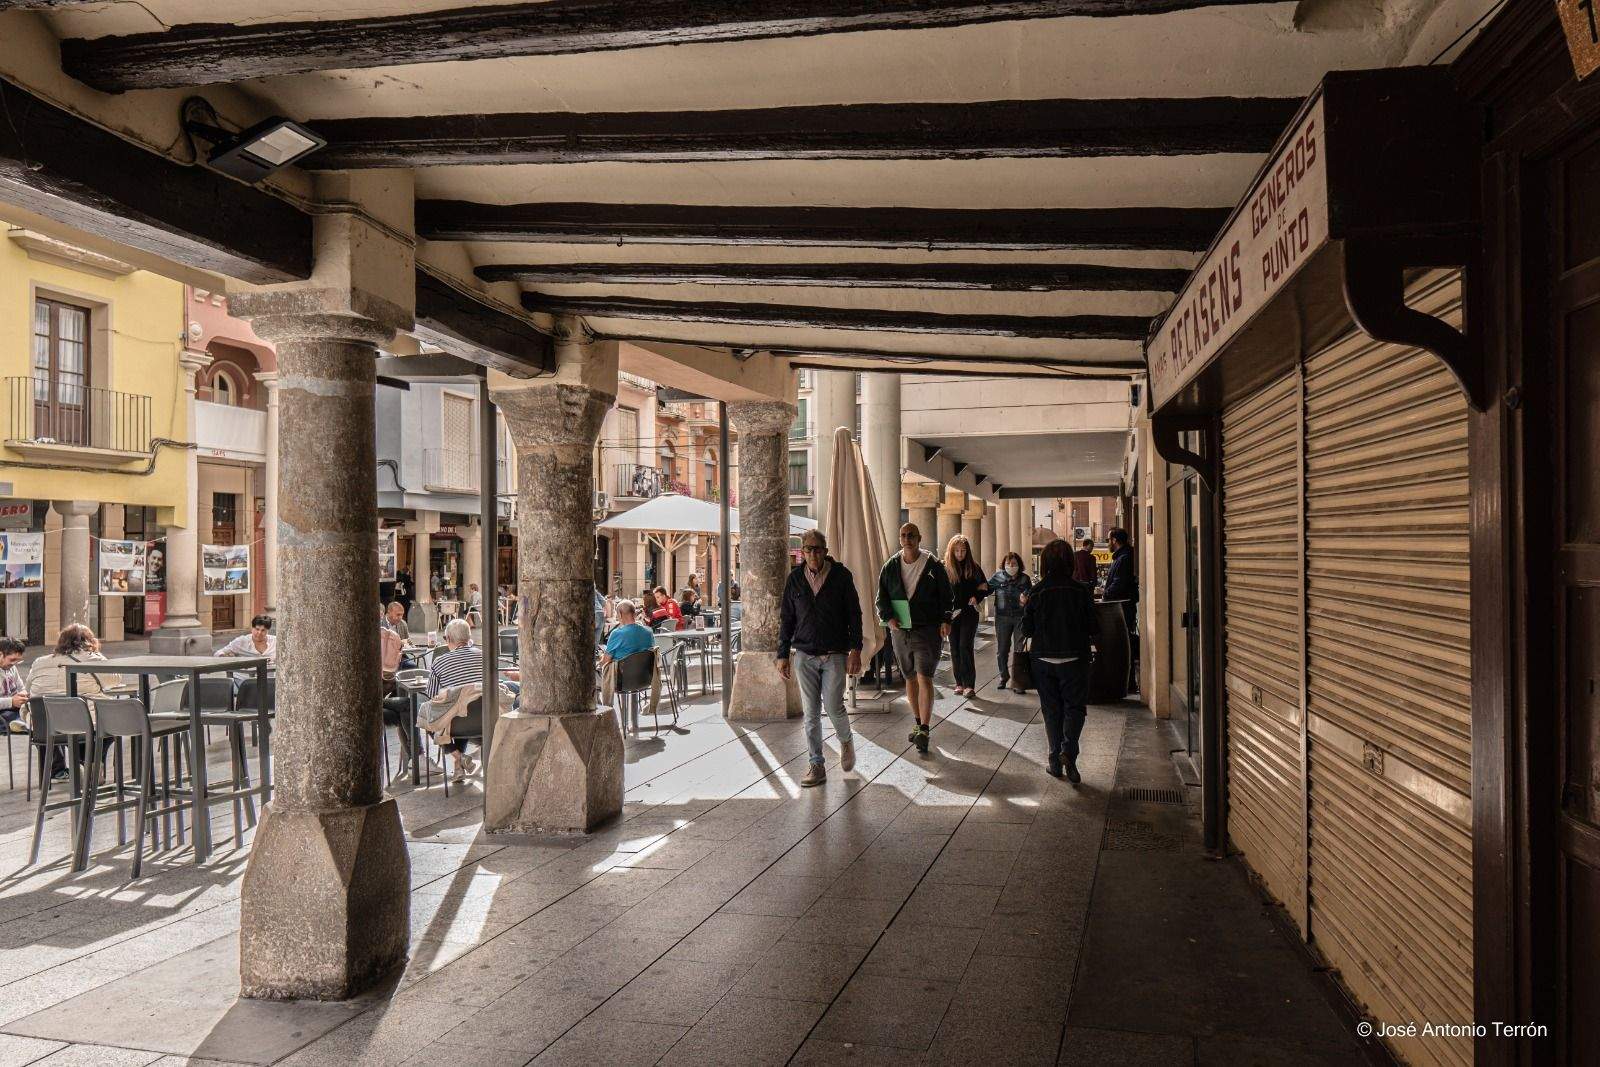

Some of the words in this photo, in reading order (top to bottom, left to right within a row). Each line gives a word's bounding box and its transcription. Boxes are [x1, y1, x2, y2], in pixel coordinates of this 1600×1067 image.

[1251, 120, 1317, 239] GENEROS
[1277, 207, 1287, 230] DE
[1262, 206, 1309, 292] PUNTO
[1170, 240, 1243, 379] RECASENS
